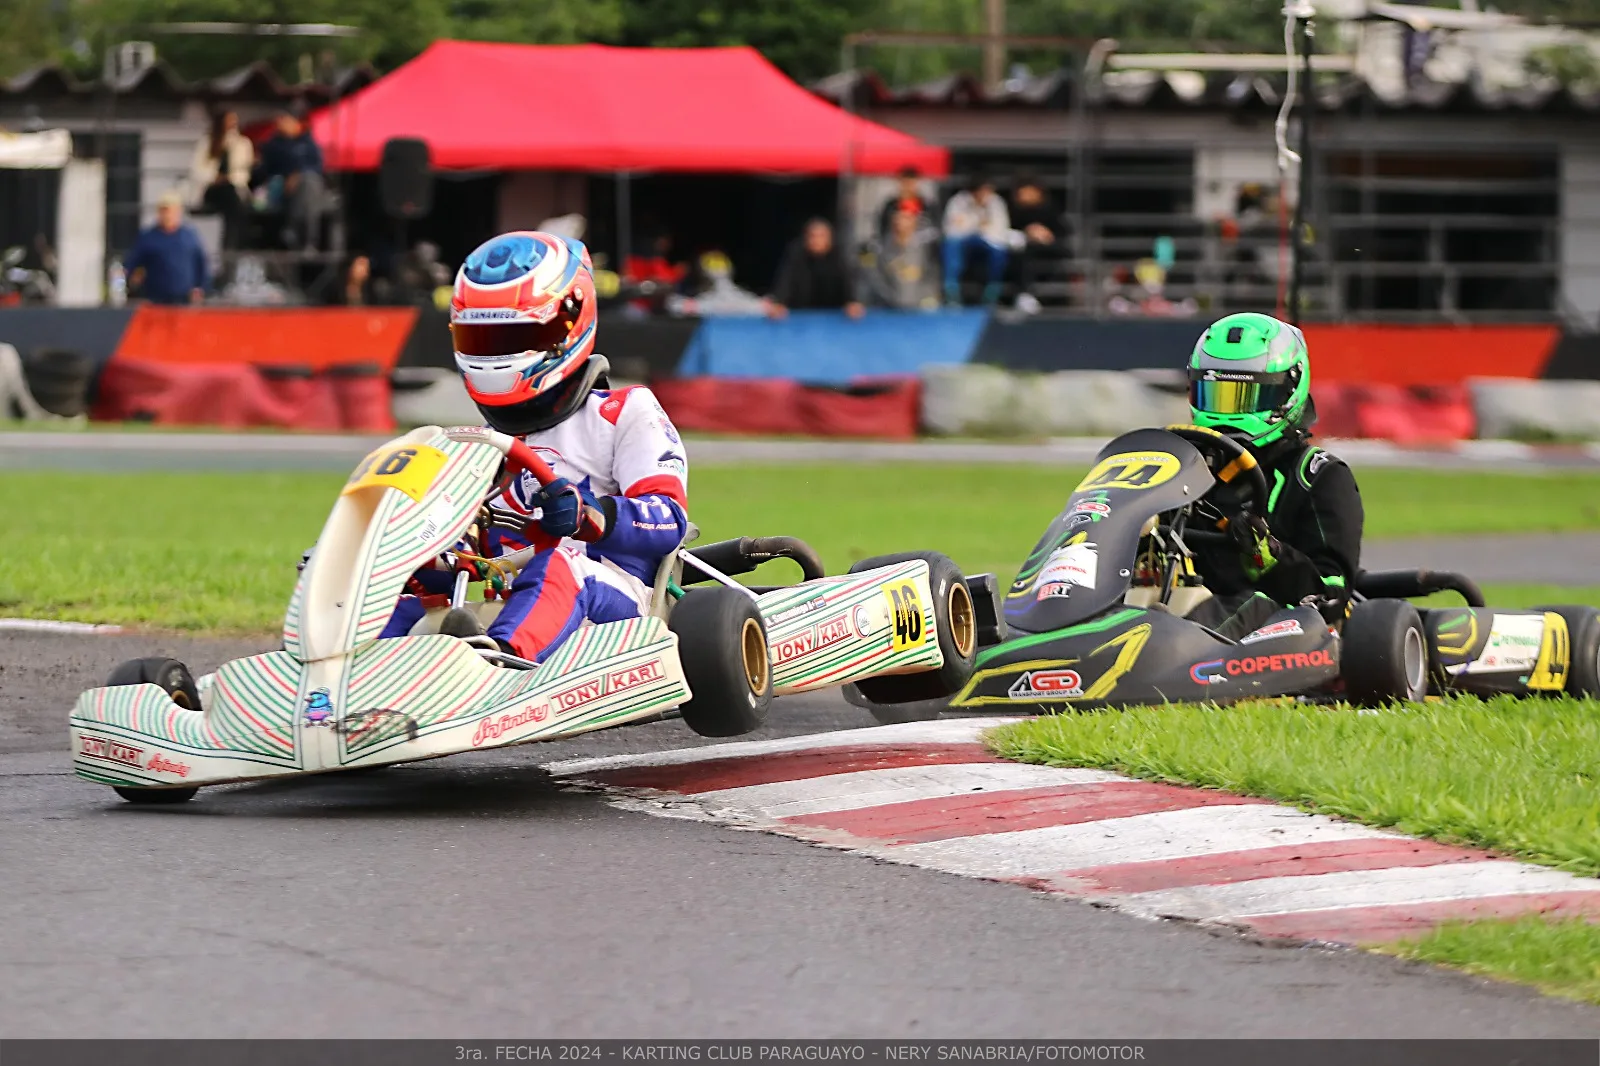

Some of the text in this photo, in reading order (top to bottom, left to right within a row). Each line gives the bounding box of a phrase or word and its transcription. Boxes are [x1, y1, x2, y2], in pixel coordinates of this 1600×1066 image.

[470, 310, 518, 320] SAMANIEGO
[1038, 583, 1072, 598] BRT
[890, 584, 922, 645] 46
[1225, 649, 1335, 676] COPETROL
[551, 660, 661, 712] TONY KART
